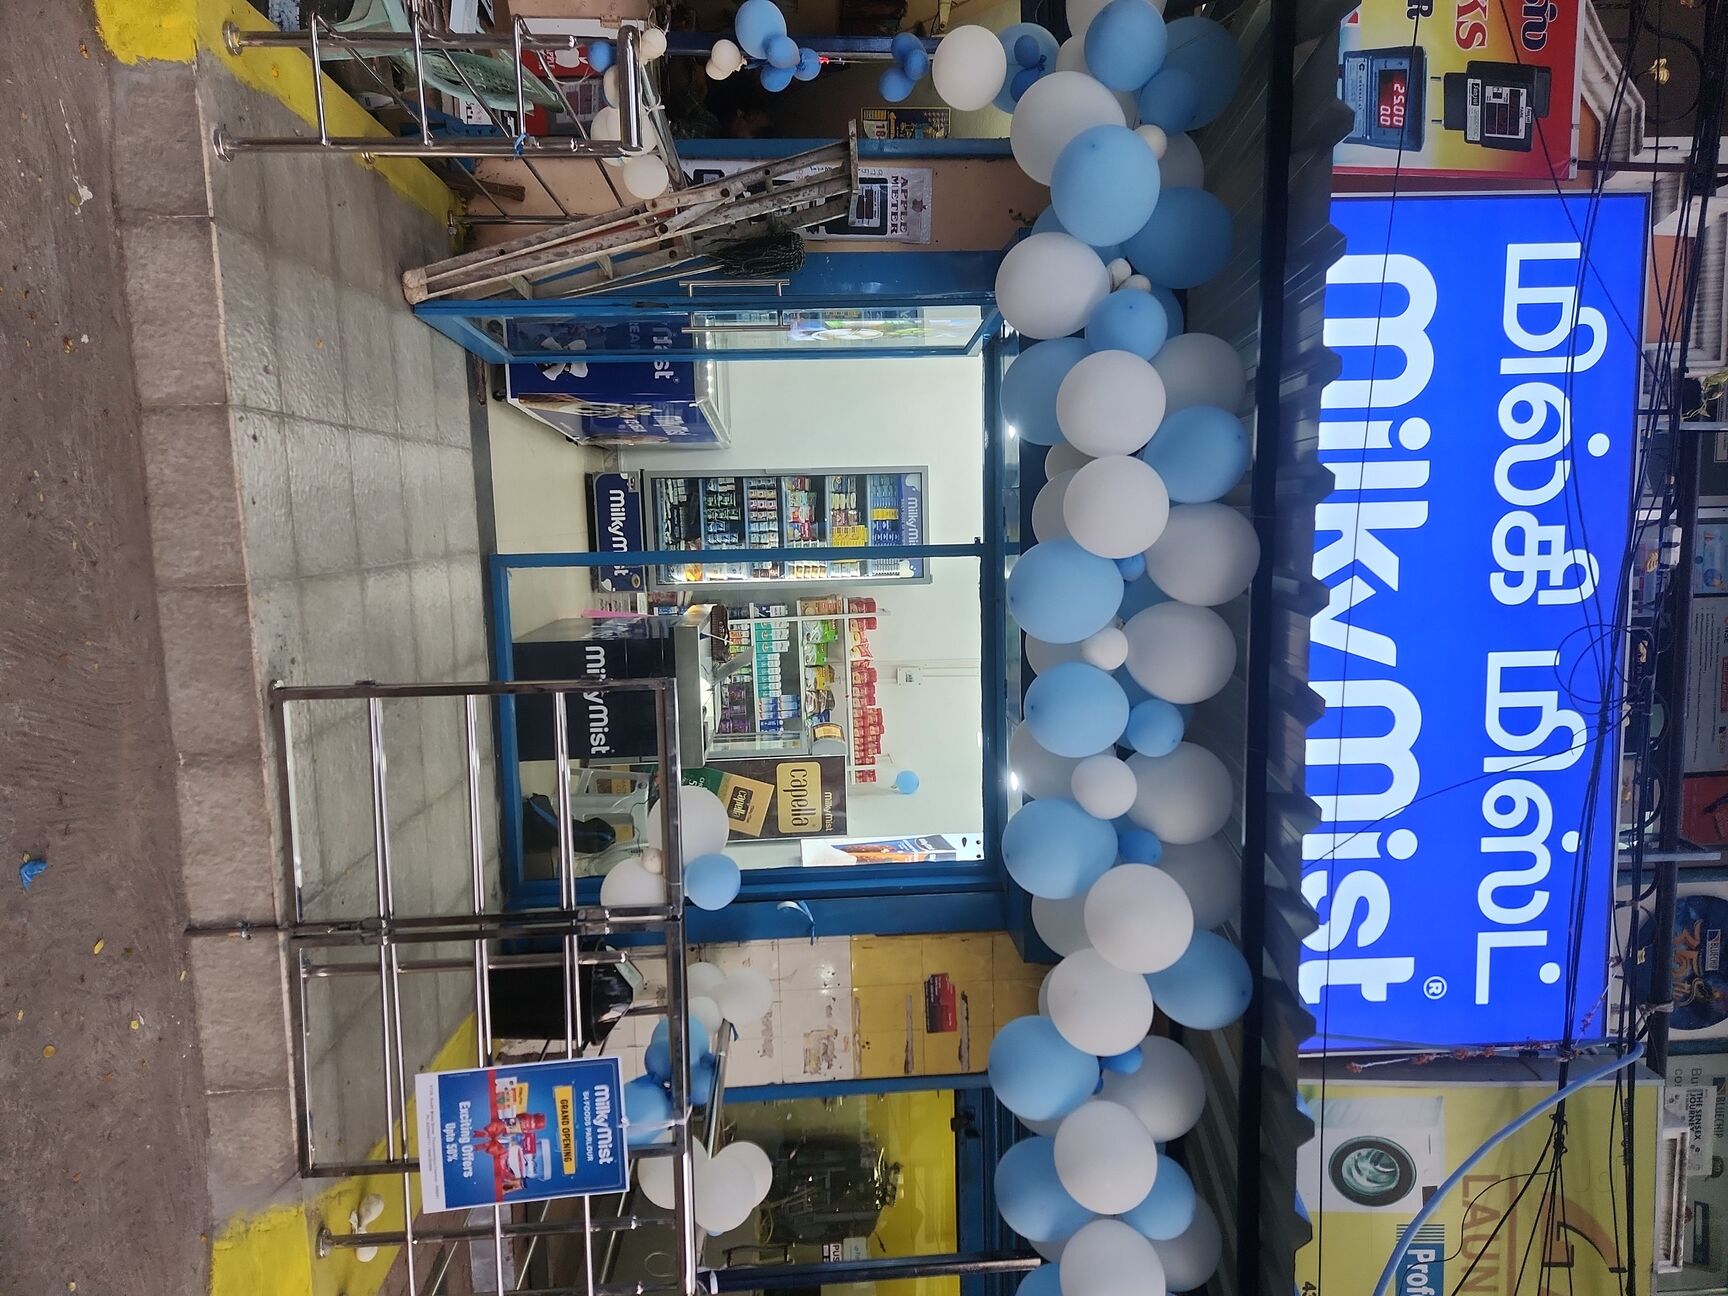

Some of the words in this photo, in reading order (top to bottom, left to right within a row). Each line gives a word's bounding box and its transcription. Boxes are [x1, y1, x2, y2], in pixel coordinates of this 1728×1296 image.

[890, 175, 899, 235] METER
[899, 176, 909, 233] APPLE
[1488, 241, 1610, 606] மில்கி
[732, 790, 749, 818] capella
[782, 768, 817, 827] capella
[1475, 650, 1588, 1005] மிஸ்ட்
[559, 1098, 570, 1126] GRAND
[583, 1101, 591, 1126] FOODS
[1688, 1092, 1696, 1132] JOURNEY
[1694, 1092, 1704, 1108] THE
[1714, 1095, 1726, 1138] BLUECHIP
[442, 1122, 457, 1143] Upto
[458, 1101, 473, 1143] Exciting
[1693, 1109, 1703, 1141] SENSEX
[445, 1143, 459, 1163] 50%
[461, 1144, 475, 1178] Offers
[561, 1127, 573, 1163] OPENING
[585, 1127, 594, 1162] PARLOUR
[1406, 1249, 1437, 1296] Prof
